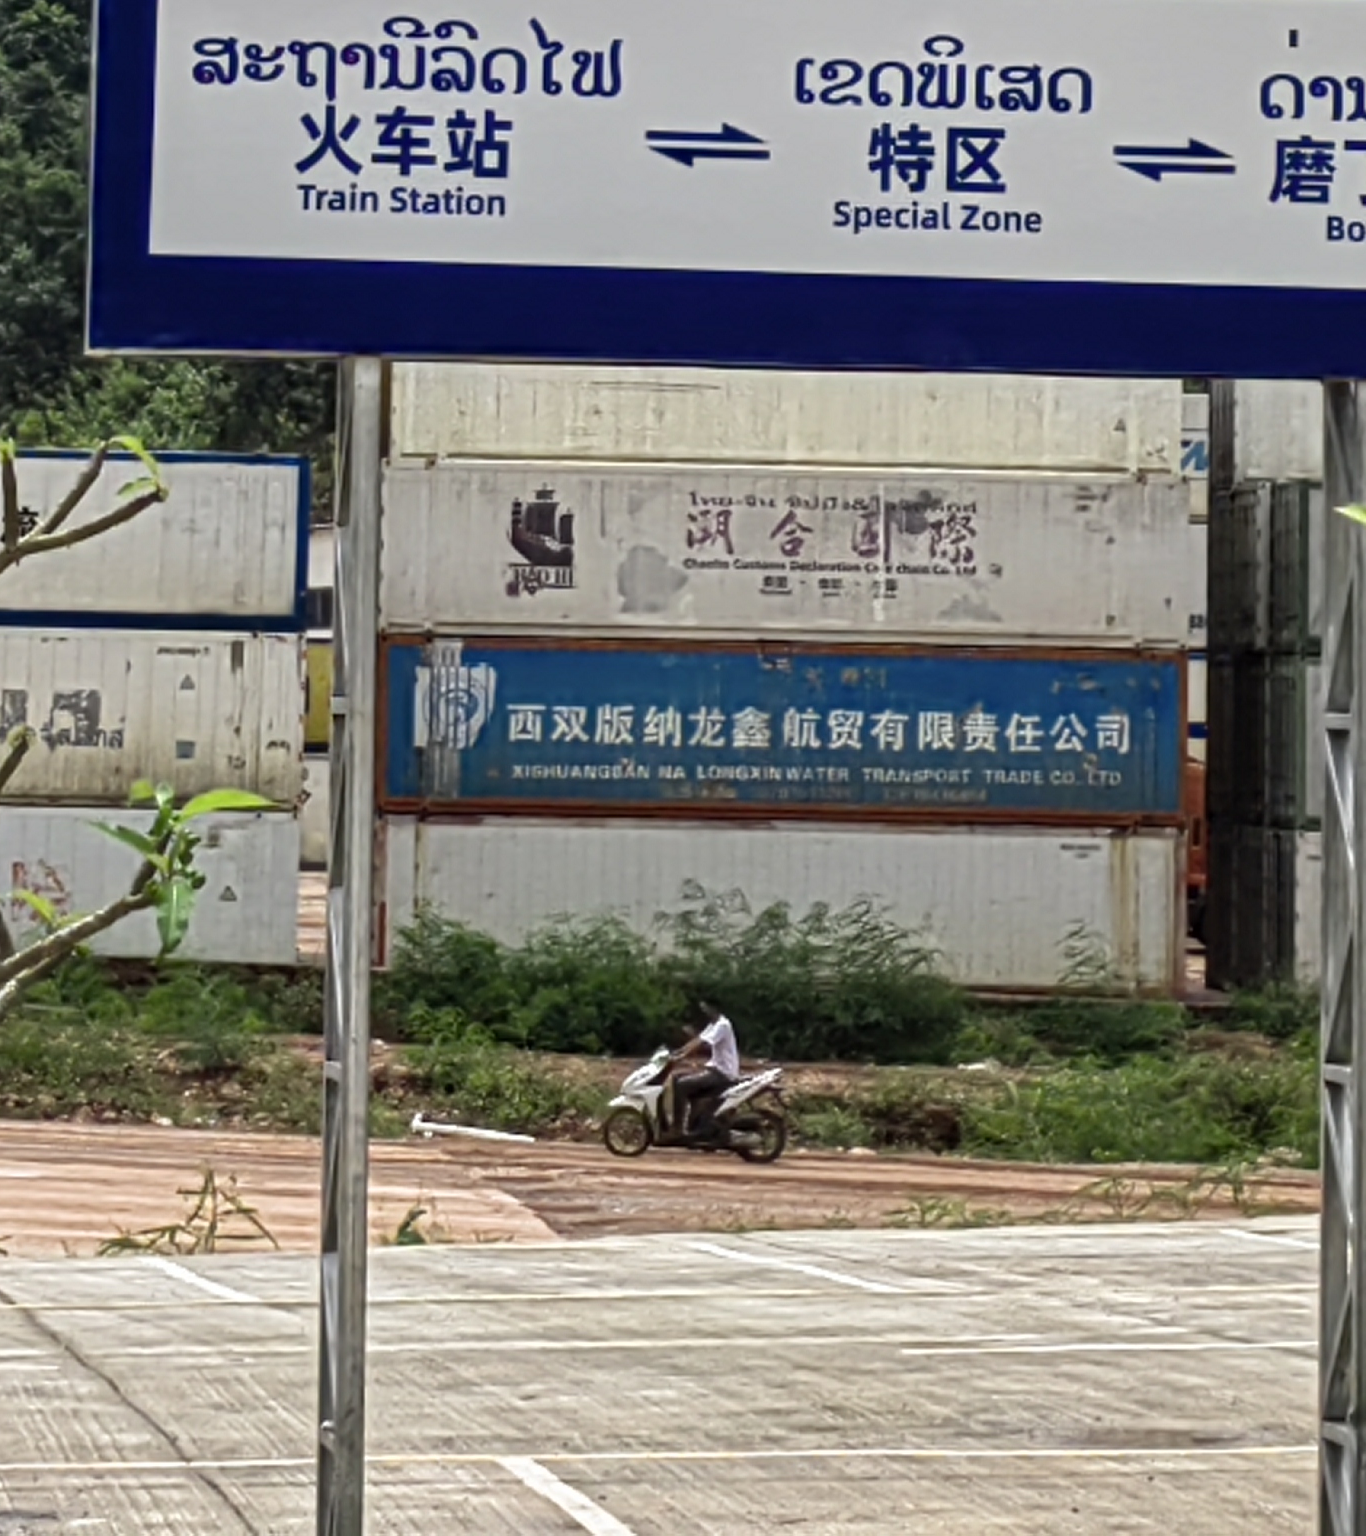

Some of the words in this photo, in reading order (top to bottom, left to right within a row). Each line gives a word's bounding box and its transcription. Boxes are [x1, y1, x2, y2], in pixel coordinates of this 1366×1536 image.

[191, 14, 624, 104] ສະຖານີລົດໄຟ
[793, 33, 1094, 115] ເຂດພິເສດ
[293, 102, 514, 178] 火车站
[866, 121, 1008, 195] 特区
[295, 181, 380, 214] Train
[388, 185, 507, 217] Station
[832, 199, 952, 236] Special
[958, 203, 1043, 235] Zone
[505, 702, 1132, 755] 西双版纳龙鑫航贸有限责任公司
[785, 767, 850, 783] WATER
[862, 768, 972, 784] TRANSPORT
[985, 769, 1044, 785] TRADE
